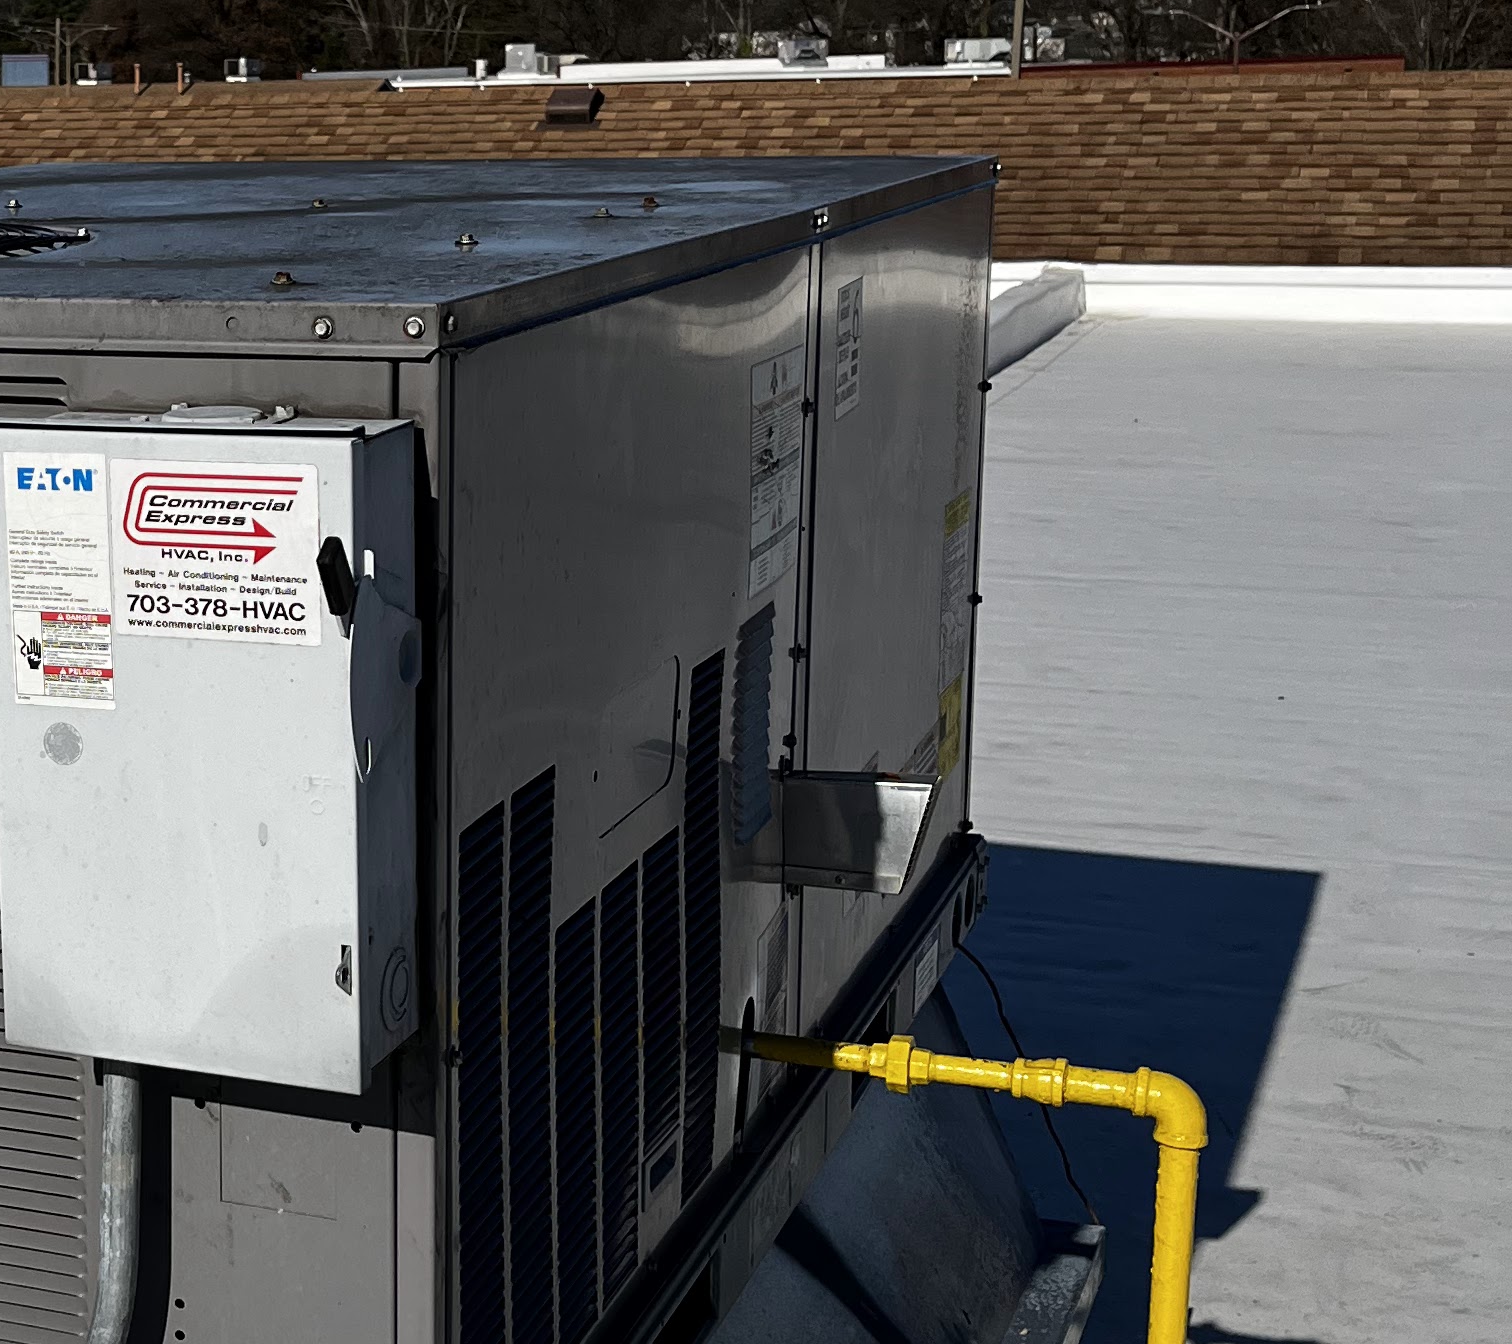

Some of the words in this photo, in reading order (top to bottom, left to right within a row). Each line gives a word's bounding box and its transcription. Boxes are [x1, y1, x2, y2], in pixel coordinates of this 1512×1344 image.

[17, 467, 93, 492] EATON
[149, 495, 294, 513] Commercial
[145, 510, 246, 526] Express
[161, 548, 214, 563] HVAC,
[218, 551, 249, 563] Inc.
[123, 567, 156, 578] Heating
[167, 570, 179, 578] Air
[183, 570, 239, 582] Conditioning
[251, 574, 308, 584] Maintenance
[134, 580, 167, 590] Service
[178, 583, 228, 593] Installation
[239, 586, 297, 596] Design/Build
[126, 594, 306, 622] 703-378-HVAC
[65, 613, 98, 623] DANGER
[128, 618, 307, 636] www.commercialexpresshvac.com
[68, 667, 102, 677] PELIGRO
